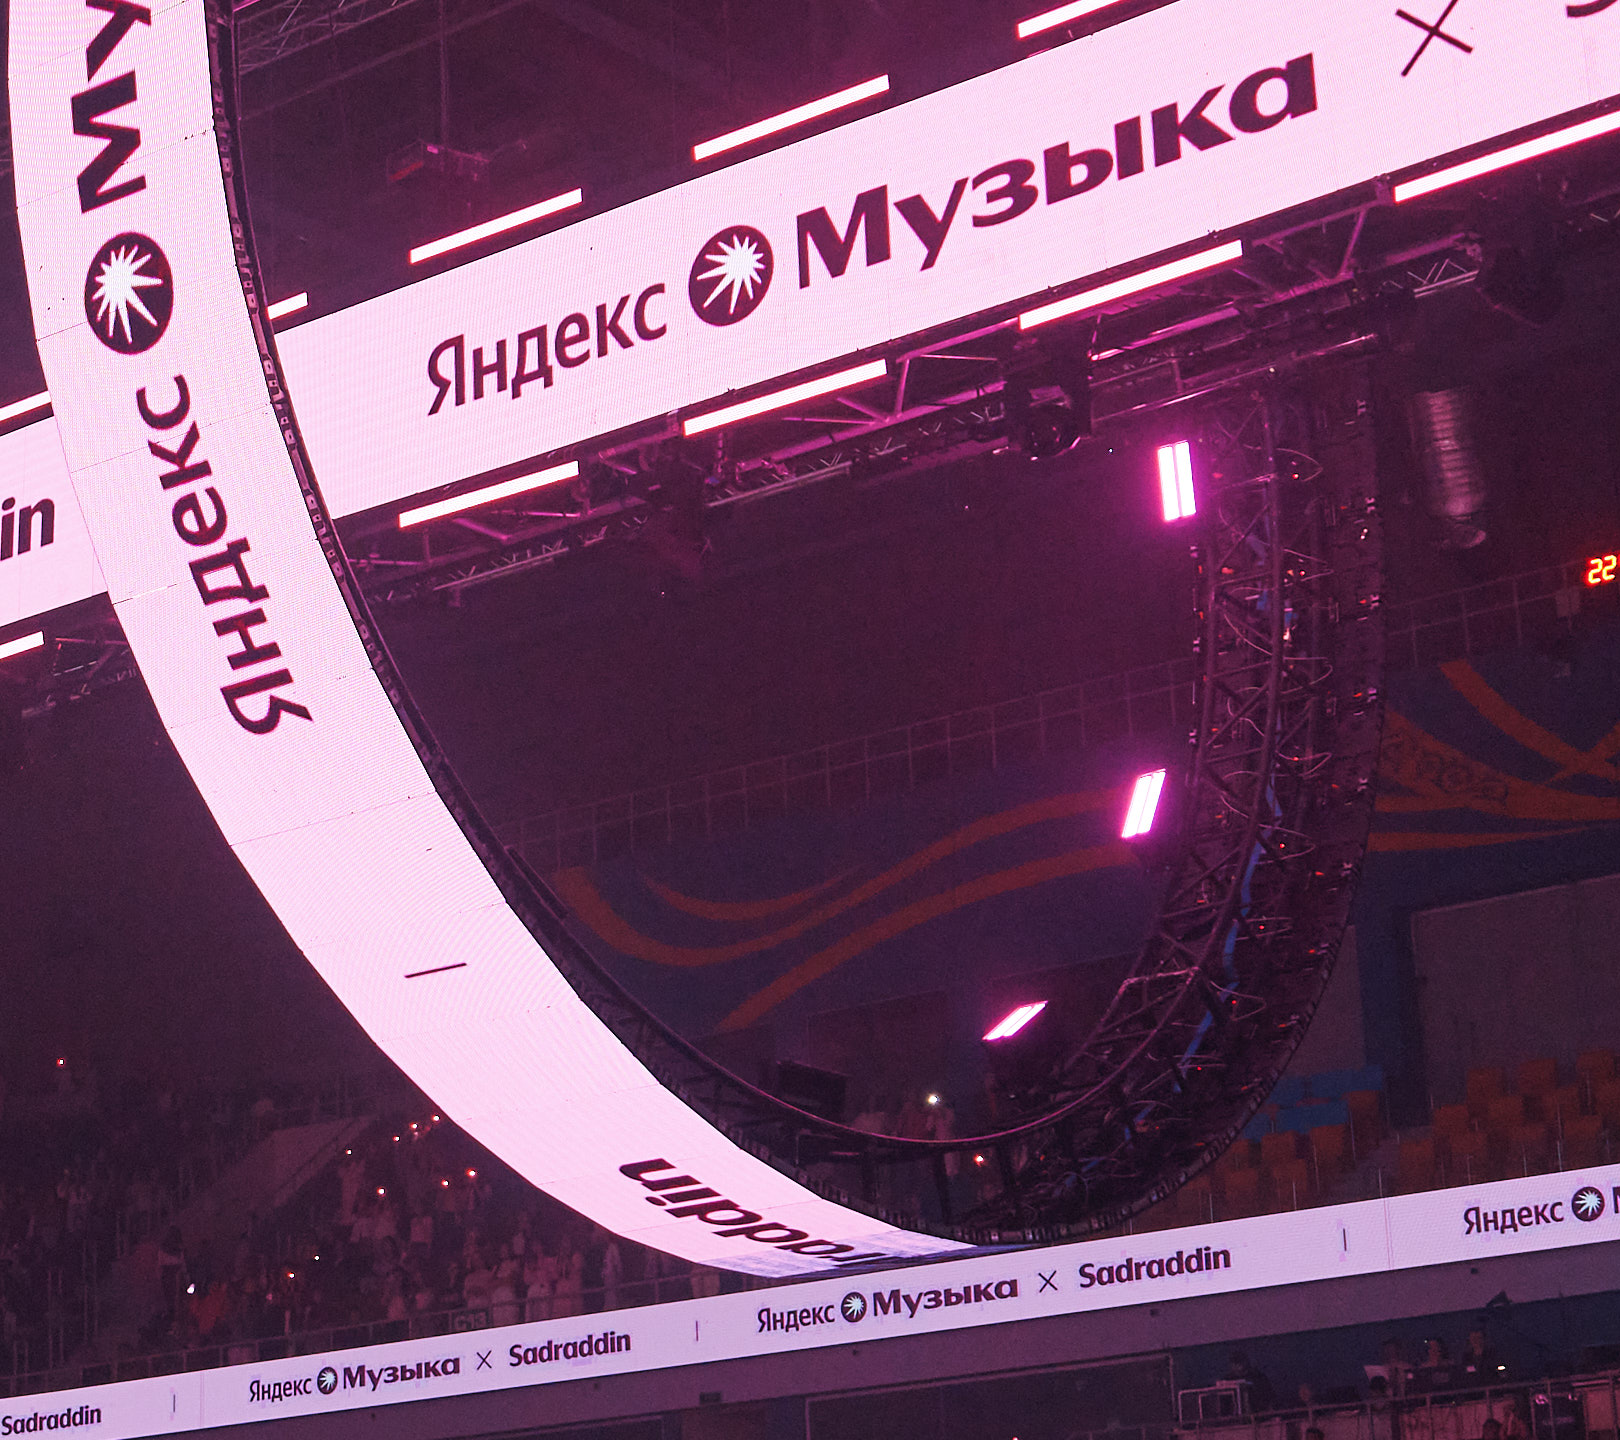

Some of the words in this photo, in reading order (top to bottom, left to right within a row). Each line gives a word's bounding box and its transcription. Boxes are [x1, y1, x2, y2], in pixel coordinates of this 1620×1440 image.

[428, 283, 667, 416] Яндекс
[796, 53, 1317, 289] Музыка
[132, 373, 317, 740] Яндекс
[1464, 1202, 1564, 1235] Яндекс
[758, 1305, 835, 1332] Яндекс
[873, 1279, 1018, 1318] Музыка
[1079, 1246, 1231, 1288] Sadraddin
[250, 1378, 311, 1402] Яндекс
[344, 1358, 460, 1391] Музыка
[510, 1331, 631, 1367] Sadraddin
[2, 1405, 101, 1435] Sadraddin
